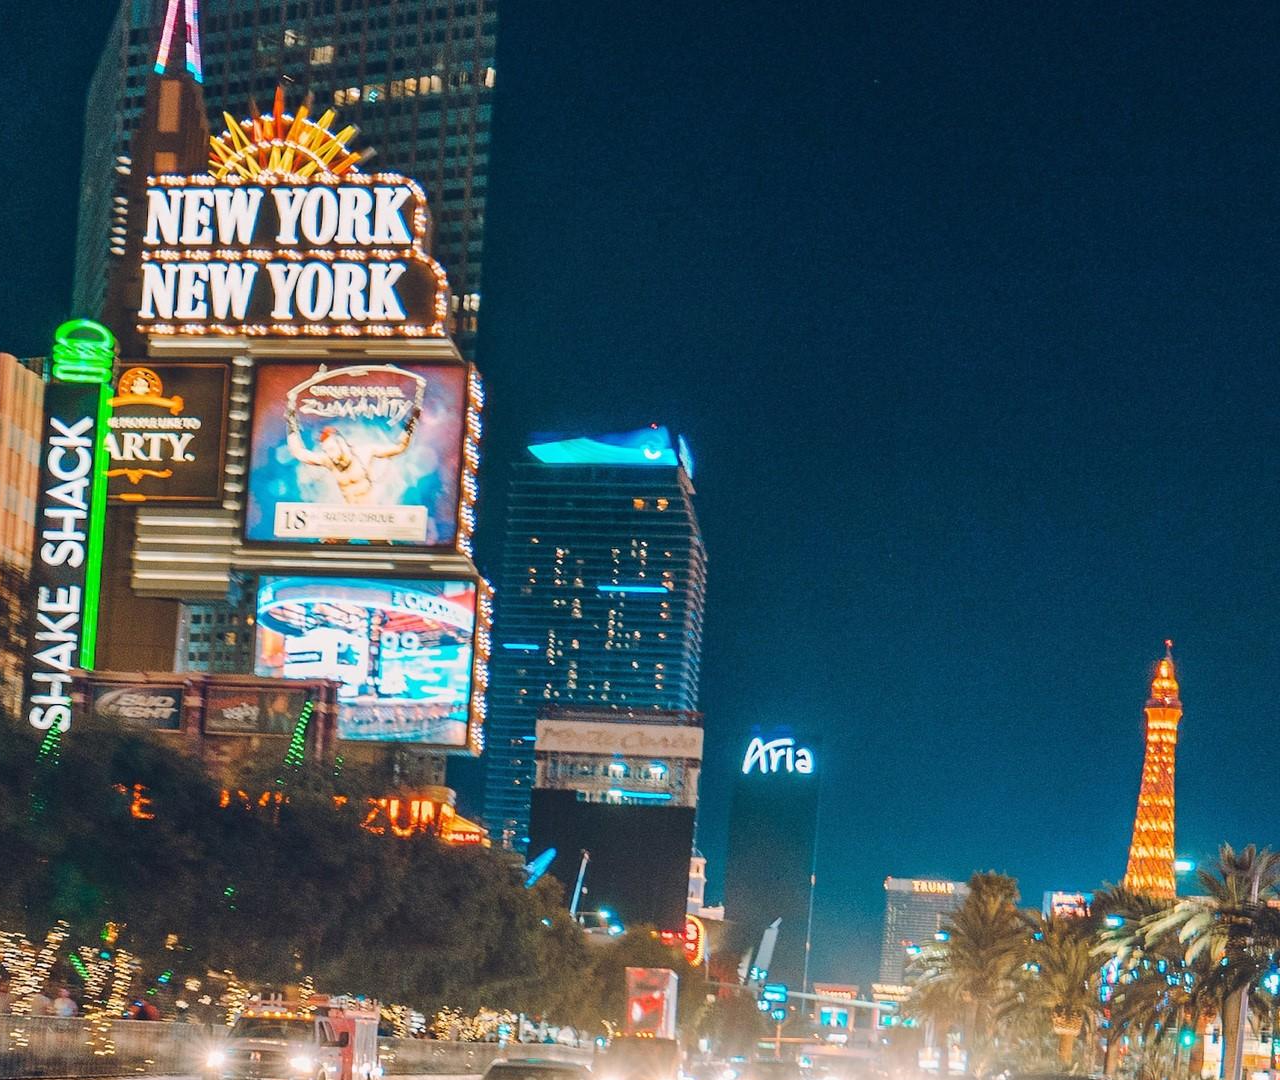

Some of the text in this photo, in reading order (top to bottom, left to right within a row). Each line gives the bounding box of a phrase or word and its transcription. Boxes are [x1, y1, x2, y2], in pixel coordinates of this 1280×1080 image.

[143, 187, 413, 245] NEW YORK
[138, 262, 406, 320] NEW YORK
[104, 432, 196, 461] ARTY.
[40, 415, 93, 568] SHACK
[29, 586, 82, 733] SHAKE
[742, 737, 815, 775] Aria
[912, 880, 955, 895] TRUMP
